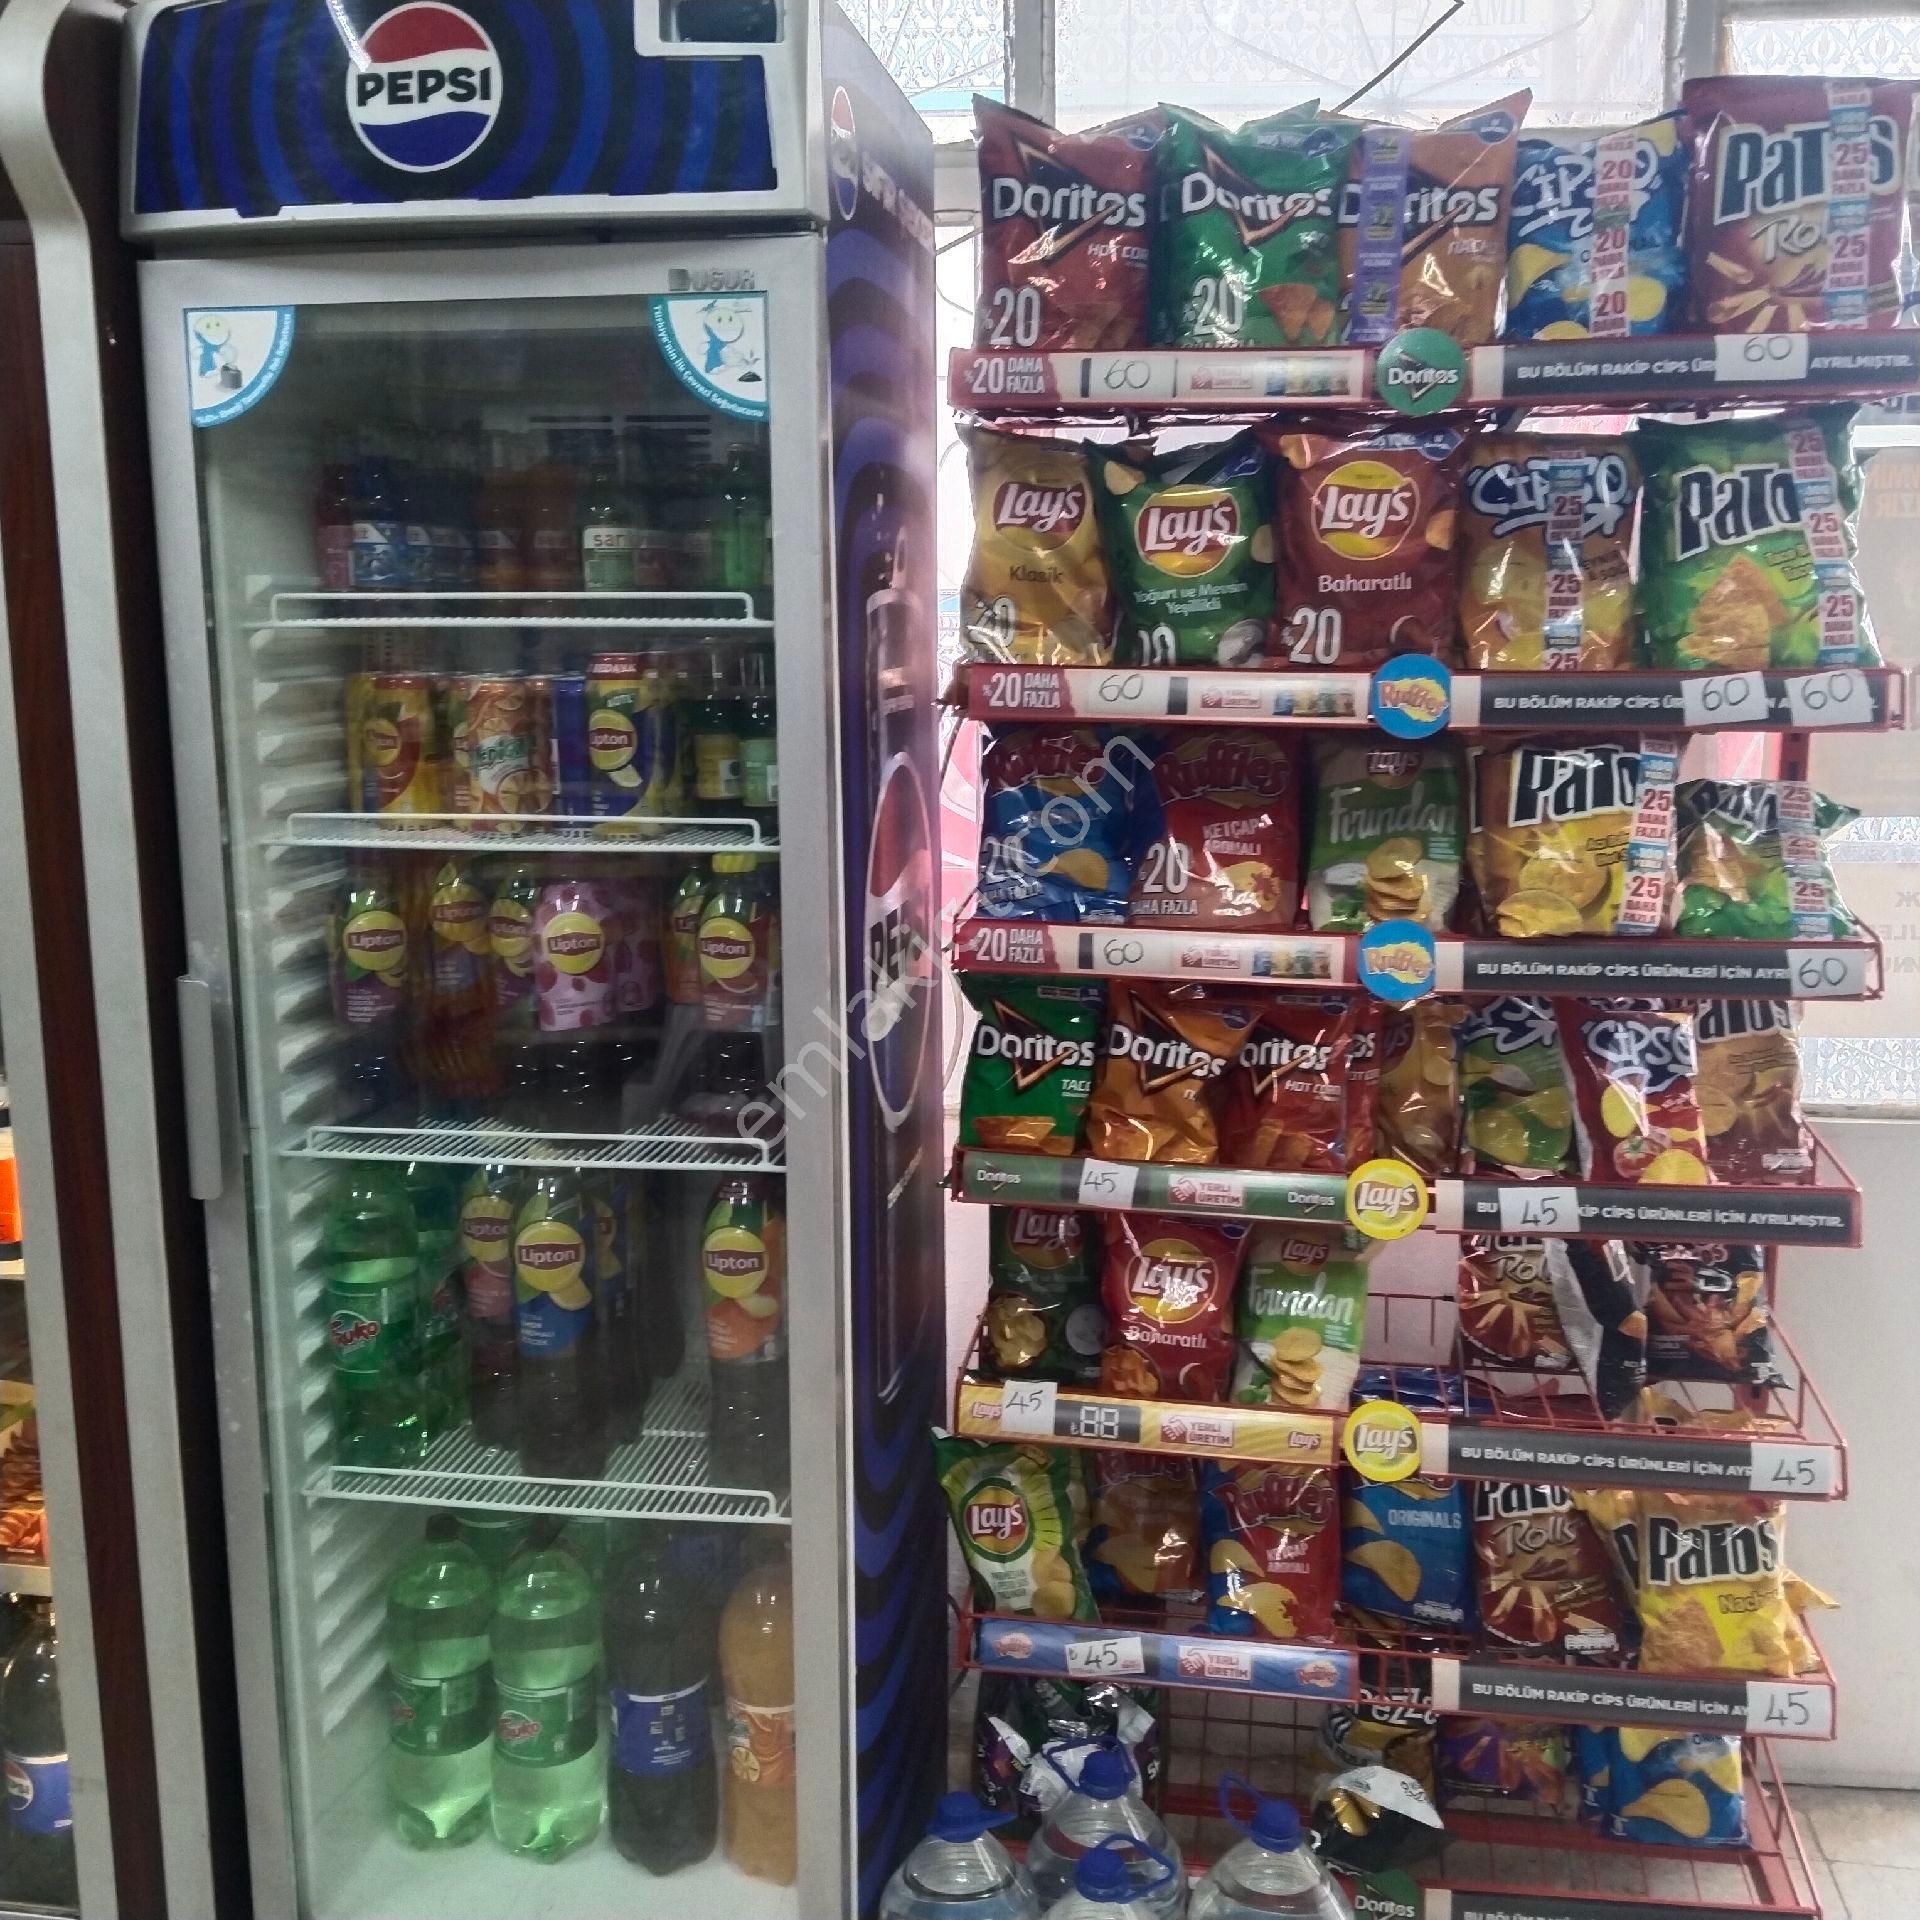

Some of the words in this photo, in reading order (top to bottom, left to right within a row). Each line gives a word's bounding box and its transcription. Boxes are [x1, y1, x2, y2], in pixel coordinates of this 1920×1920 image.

[356, 66, 492, 108] PEPSI
[1836, 143, 1868, 167] 25
[993, 177, 1146, 227] Doritos
[1182, 172, 1333, 219] Doritos
[1338, 182, 1500, 223] Dritos
[1834, 234, 1867, 259] 25
[1742, 337, 1793, 362] 60
[1007, 357, 1043, 373] DAHA
[1104, 359, 1151, 390] 60
[1387, 366, 1459, 387] Doritos
[1517, 365, 1541, 379] BU
[1006, 375, 1046, 393] FAZLA
[996, 481, 1084, 533] Lay's
[1320, 485, 1413, 539] Lay's
[1554, 495, 1583, 517] 25
[1144, 502, 1233, 557] Lay's
[1809, 512, 1840, 534] 25
[1009, 565, 1064, 584] Klasik
[1318, 573, 1412, 593] Baharatlı
[1552, 574, 1581, 595] 25
[1826, 594, 1855, 618] 25
[1023, 672, 1060, 689] DAHA
[1099, 673, 1145, 703] 60
[1800, 672, 1854, 711] 60
[1022, 690, 1061, 709] FAZLA
[1493, 696, 1517, 710] BU
[1574, 693, 1620, 709] RAKİP
[1702, 676, 1750, 711] 60
[1643, 788, 1671, 812] 25
[1630, 875, 1662, 899] 25
[1794, 881, 1825, 899] 25
[1163, 898, 1198, 916] FAZLA
[550, 936, 598, 954] Lipton
[1009, 928, 1043, 945] DAHA
[1007, 946, 1046, 964] FAZLA
[1104, 938, 1144, 967] 60
[1478, 963, 1498, 975] BU
[1500, 961, 1554, 976] BÖLÜM
[1556, 962, 1601, 977] RAKİP
[1604, 962, 1640, 978] CİPS
[1800, 957, 1848, 989] 60
[976, 1024, 1095, 1067] Doritos
[1109, 1024, 1227, 1079] Doritos
[1240, 1034, 1335, 1071] oritos
[1082, 1169, 1119, 1194] 45
[1357, 1180, 1414, 1213] Lay's
[1477, 1201, 1497, 1214] BU
[1520, 1196, 1561, 1228] 45
[1602, 1204, 1637, 1219] CİPS
[1639, 1205, 1713, 1222] ÜRÜNLERİ
[520, 1245, 576, 1265] Lipton
[706, 1252, 760, 1273] Lipton
[1005, 1390, 1044, 1413] 45
[1356, 1425, 1413, 1459] Lay's
[1461, 1446, 1481, 1459] BU
[1484, 1446, 1534, 1463] BÖLÜM
[1537, 1449, 1581, 1466] RAKİP
[1583, 1452, 1615, 1468] CİPS
[1618, 1453, 1691, 1474] ÜRÜNLERİ
[1772, 1457, 1816, 1486] 45
[970, 1503, 1025, 1539] Lay's
[1084, 1640, 1119, 1668] 45
[1472, 1682, 1492, 1696] BU
[1494, 1683, 1545, 1700] BÖLÜM
[1547, 1687, 1590, 1704] RAKİP
[1591, 1690, 1624, 1707] CİPS
[1626, 1692, 1698, 1712] ÜRÜNLERİ
[1699, 1698, 1729, 1715] İÇİN
[1764, 1691, 1811, 1726] 45
[1354, 1895, 1416, 1917] Doritos
